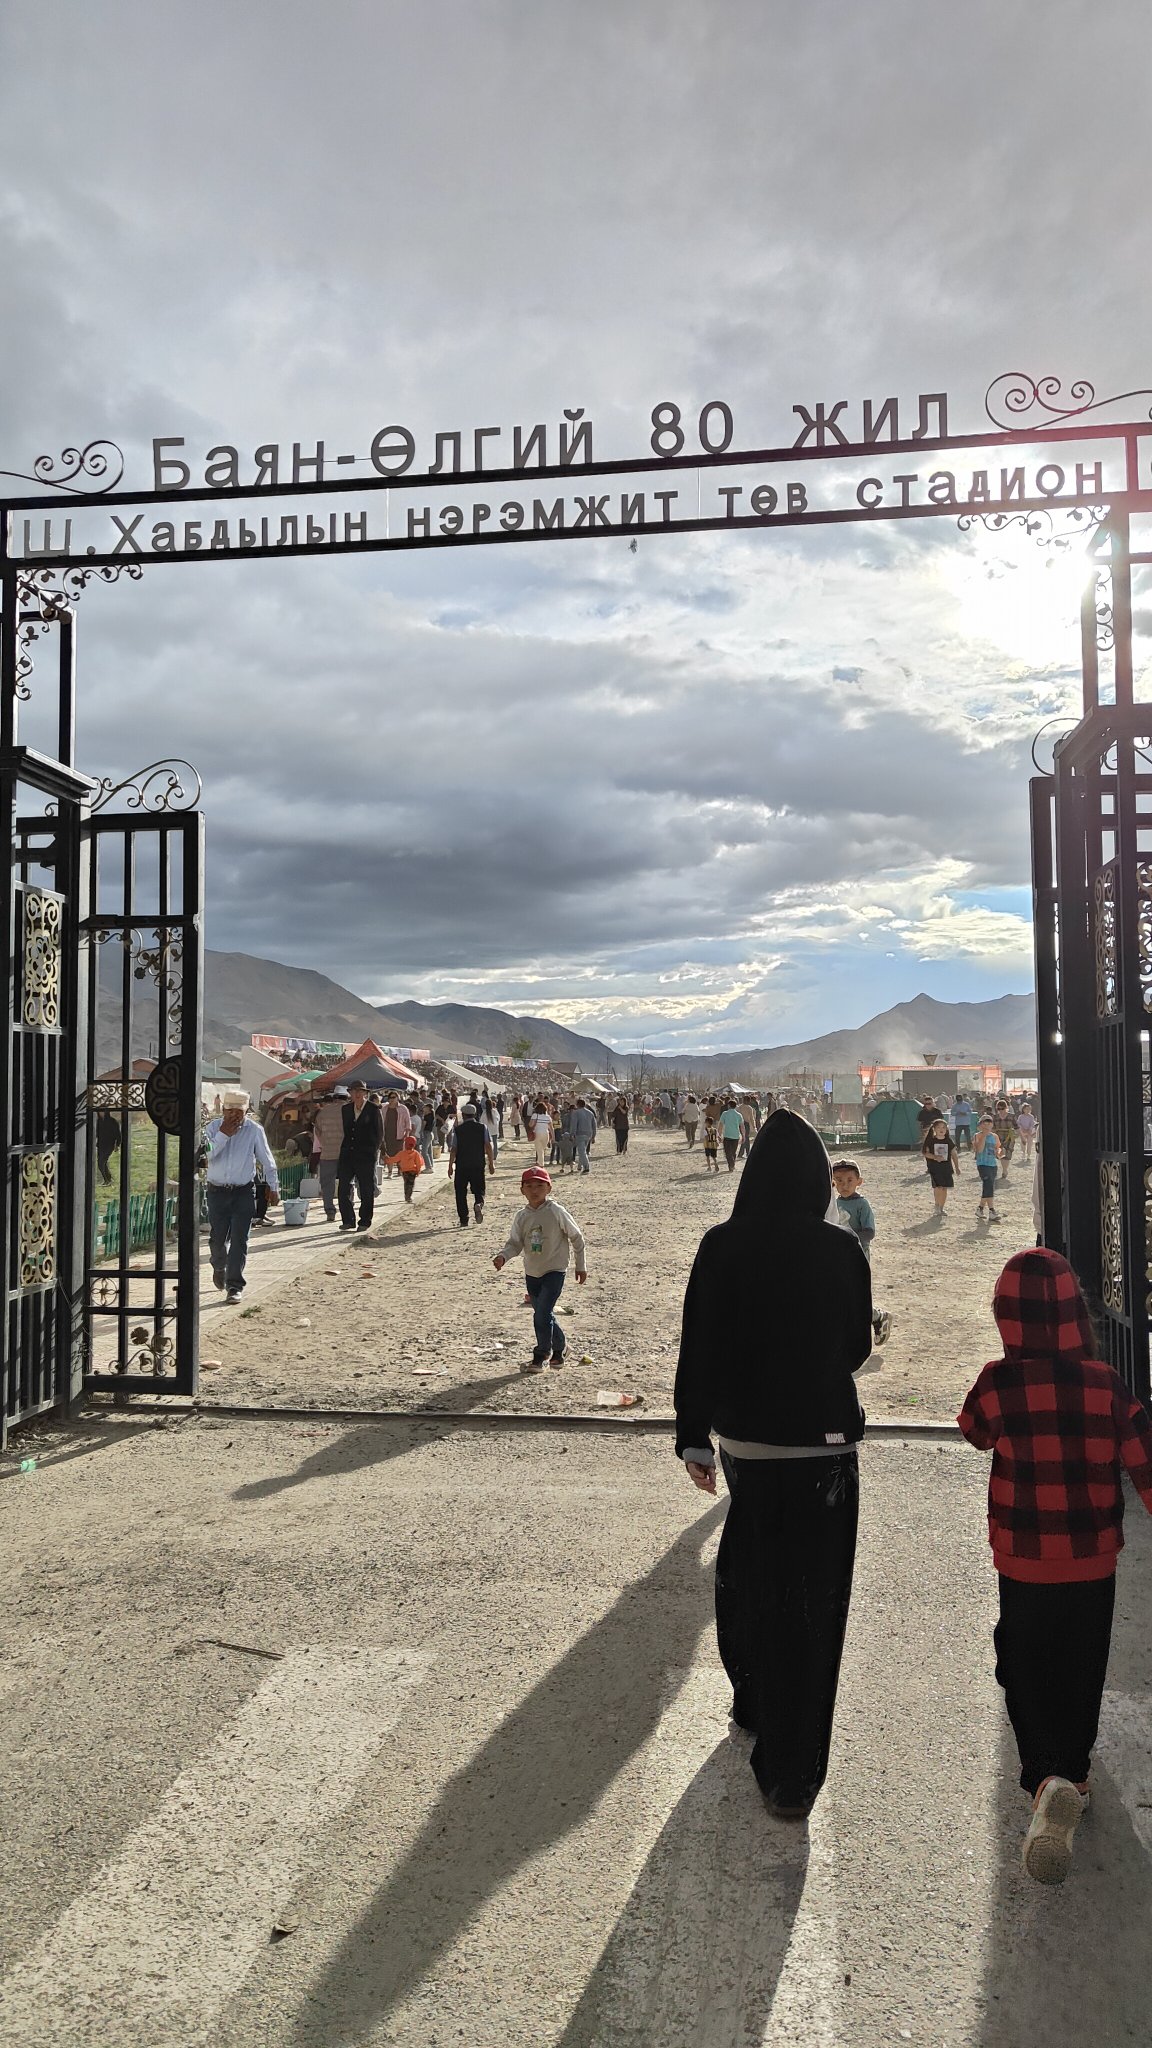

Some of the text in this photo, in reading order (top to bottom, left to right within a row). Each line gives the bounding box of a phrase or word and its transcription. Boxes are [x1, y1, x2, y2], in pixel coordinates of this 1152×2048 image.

[152, 408, 593, 491] Баян-Өлгий
[650, 400, 734, 457] 80
[407, 490, 679, 538] нэрэмжит
[708, 482, 808, 518] төв
[856, 461, 1102, 509] стадион
